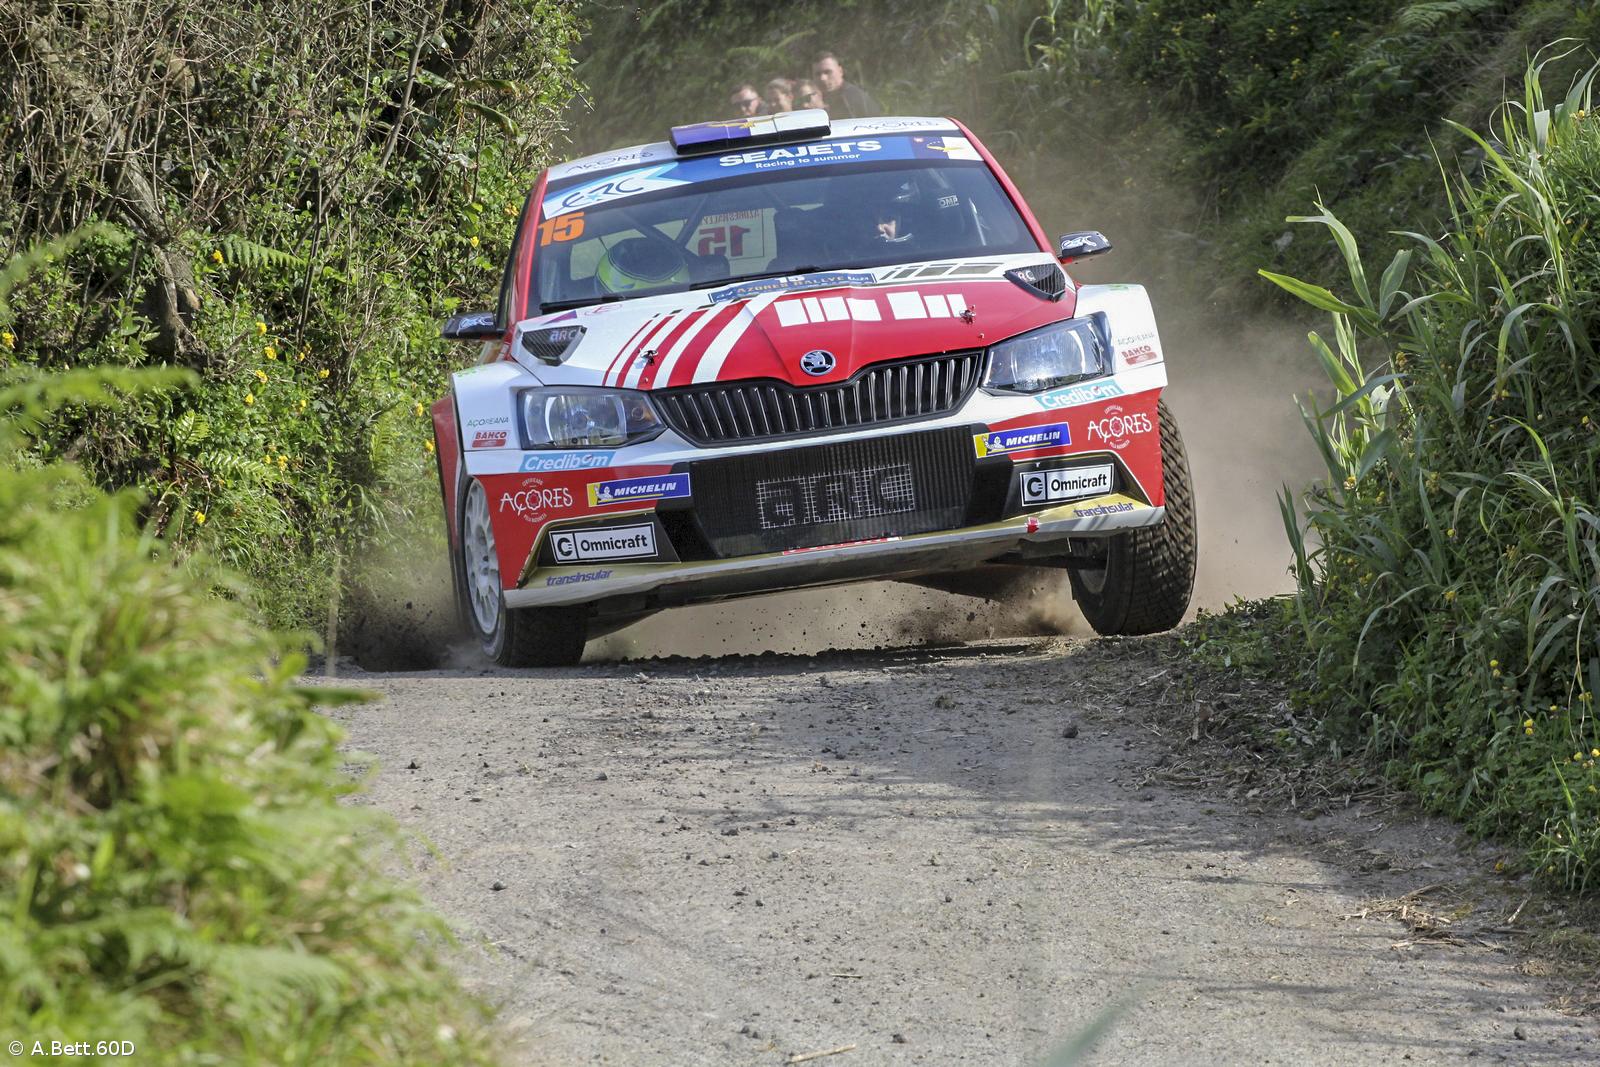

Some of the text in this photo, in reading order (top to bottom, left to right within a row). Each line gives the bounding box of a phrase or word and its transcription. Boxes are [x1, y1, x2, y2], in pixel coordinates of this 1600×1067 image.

[719, 140, 882, 167] SEAJETS
[755, 159, 795, 169] Racing
[814, 153, 861, 163] summer
[554, 177, 644, 213] ERC
[538, 212, 586, 247] 15
[1042, 384, 1122, 408] Credibom
[475, 431, 507, 440] BAHCO
[1088, 413, 1152, 444] AÇORES
[1006, 431, 1060, 446] MICHELIN
[525, 453, 609, 471] Credibom
[614, 482, 677, 497] MICHELIN
[1051, 473, 1107, 492] Omnicraft
[499, 487, 574, 516] AÇORES
[1073, 501, 1134, 518] transinsular
[580, 534, 648, 552] Omnicraft
[546, 569, 613, 586] transinsular
